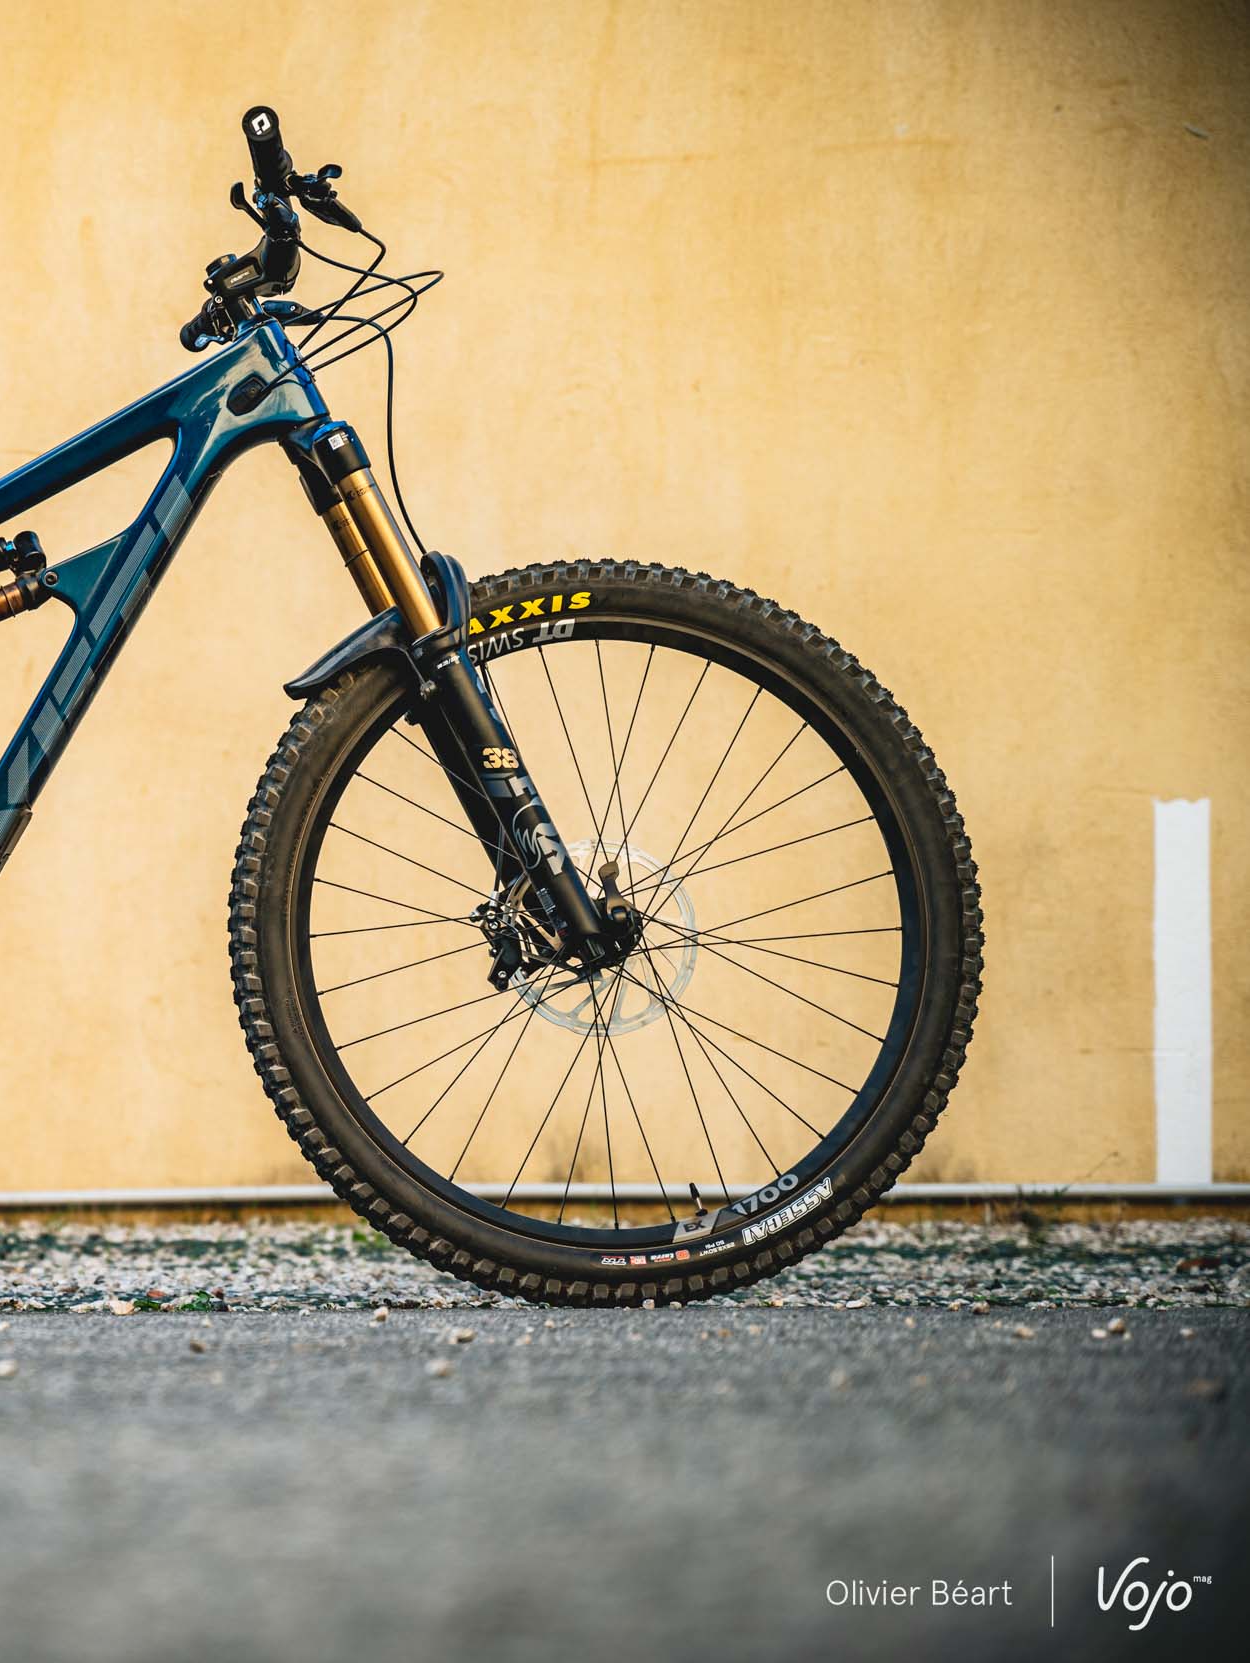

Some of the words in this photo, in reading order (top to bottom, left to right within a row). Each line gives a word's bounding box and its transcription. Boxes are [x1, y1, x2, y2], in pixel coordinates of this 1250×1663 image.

[468, 591, 592, 636] AXXIS
[532, 617, 576, 644] DT
[467, 627, 525, 667] SWIS
[482, 747, 519, 769] 38
[731, 1173, 799, 1216] 1700
[741, 1177, 834, 1246] ASSEGAI
[684, 1220, 709, 1233] EX
